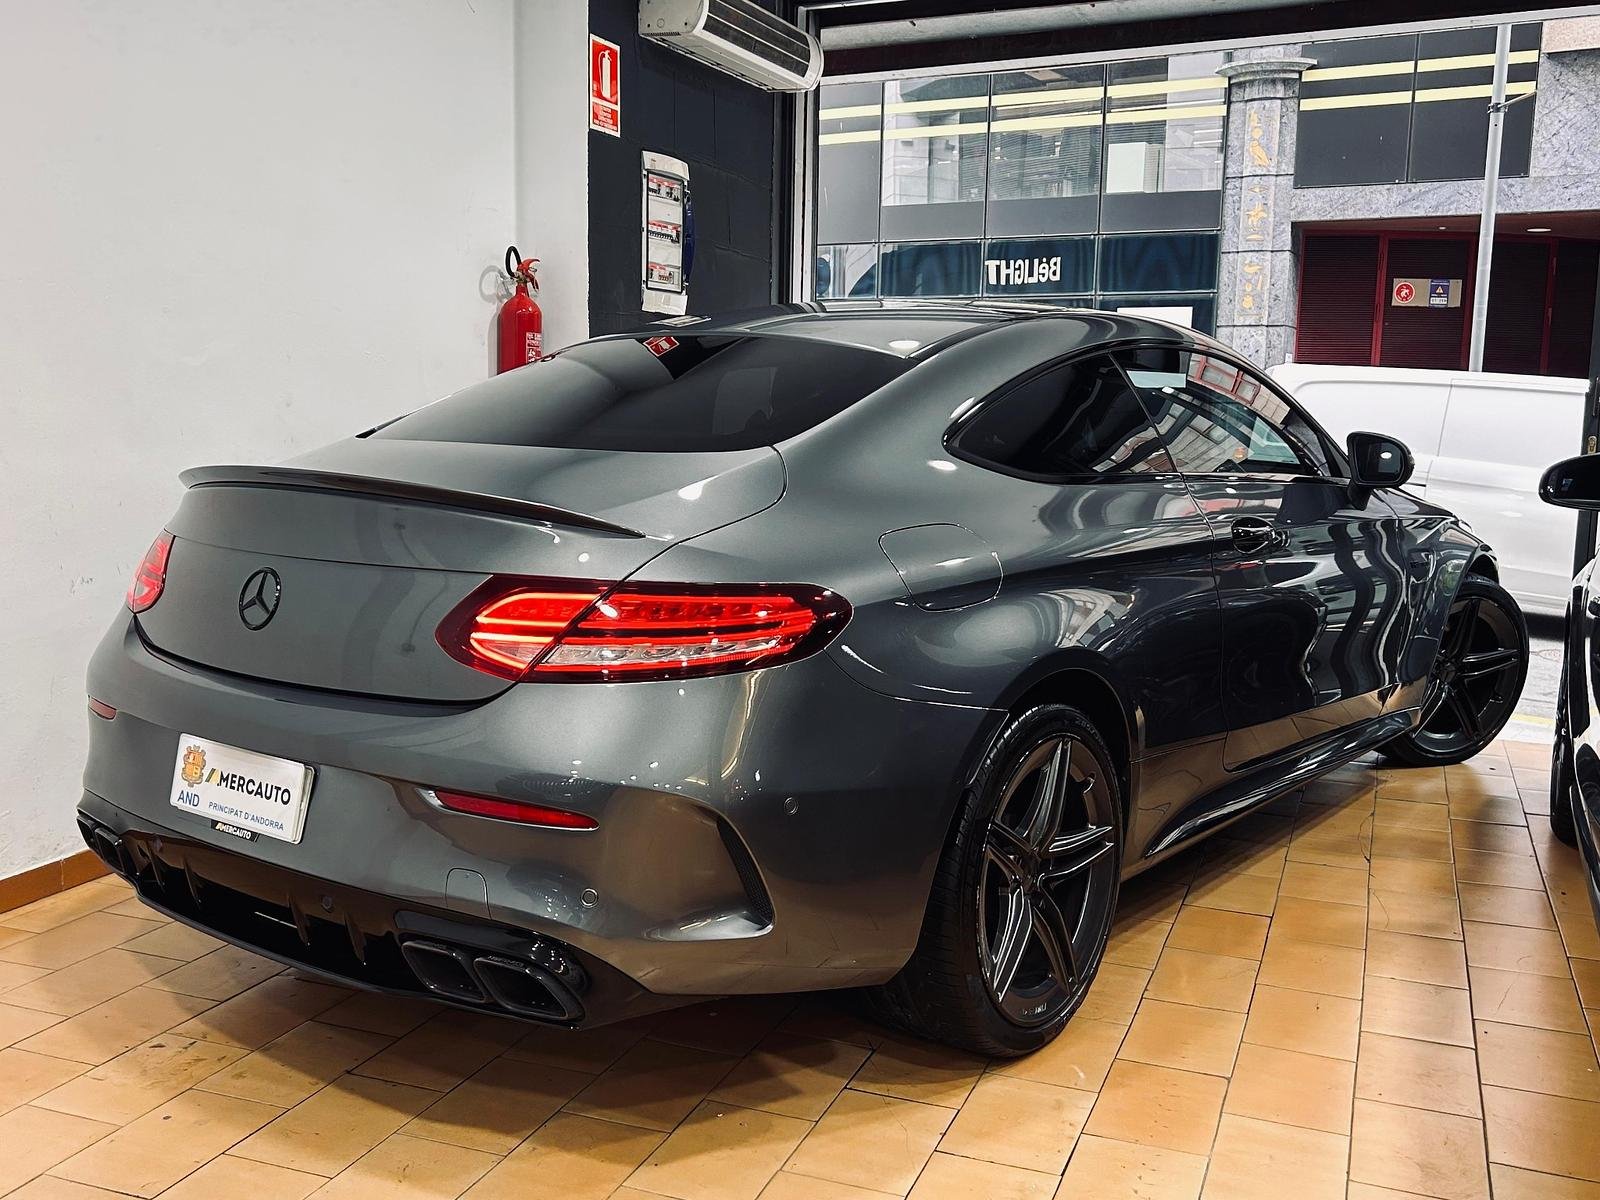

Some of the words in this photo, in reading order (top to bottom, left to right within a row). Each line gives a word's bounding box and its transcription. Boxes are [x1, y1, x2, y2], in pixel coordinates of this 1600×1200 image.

[177, 790, 200, 807] AND
[217, 770, 291, 806] MERCAUTO
[208, 801, 243, 818] PRINCIPAT
[244, 809, 284, 831] D'ANDORRA
